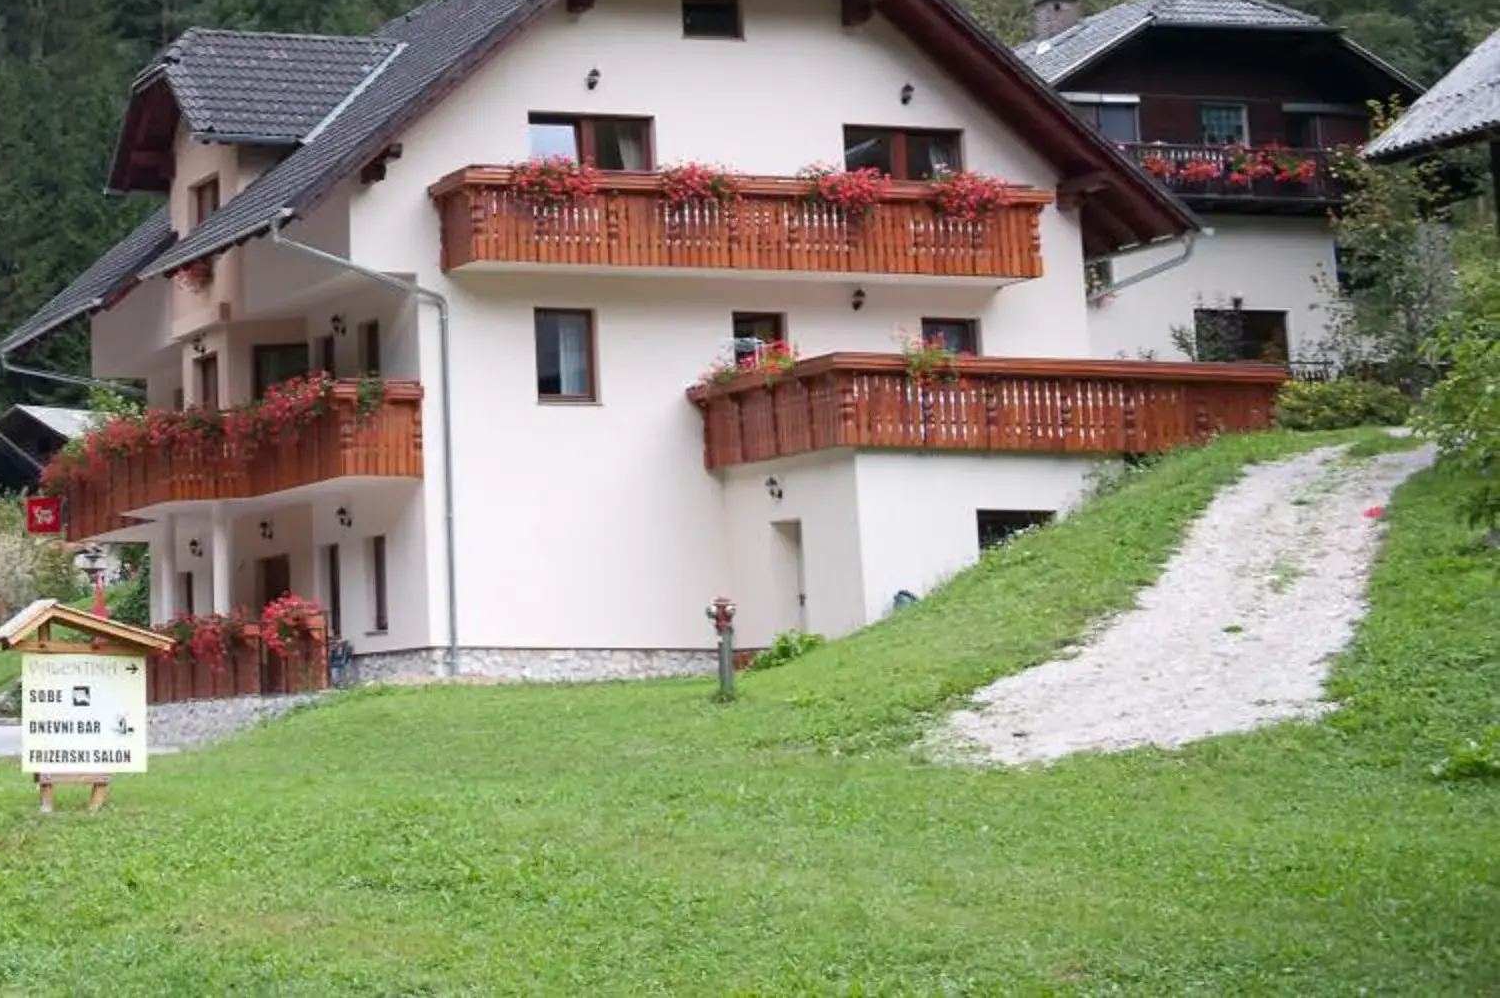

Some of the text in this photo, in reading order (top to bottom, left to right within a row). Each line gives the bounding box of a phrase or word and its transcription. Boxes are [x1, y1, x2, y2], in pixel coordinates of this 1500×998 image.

[29, 689, 63, 703] SOBE
[29, 720, 101, 734] DNEVNI BAR
[29, 749, 132, 763] FRIZERSKI SALON
